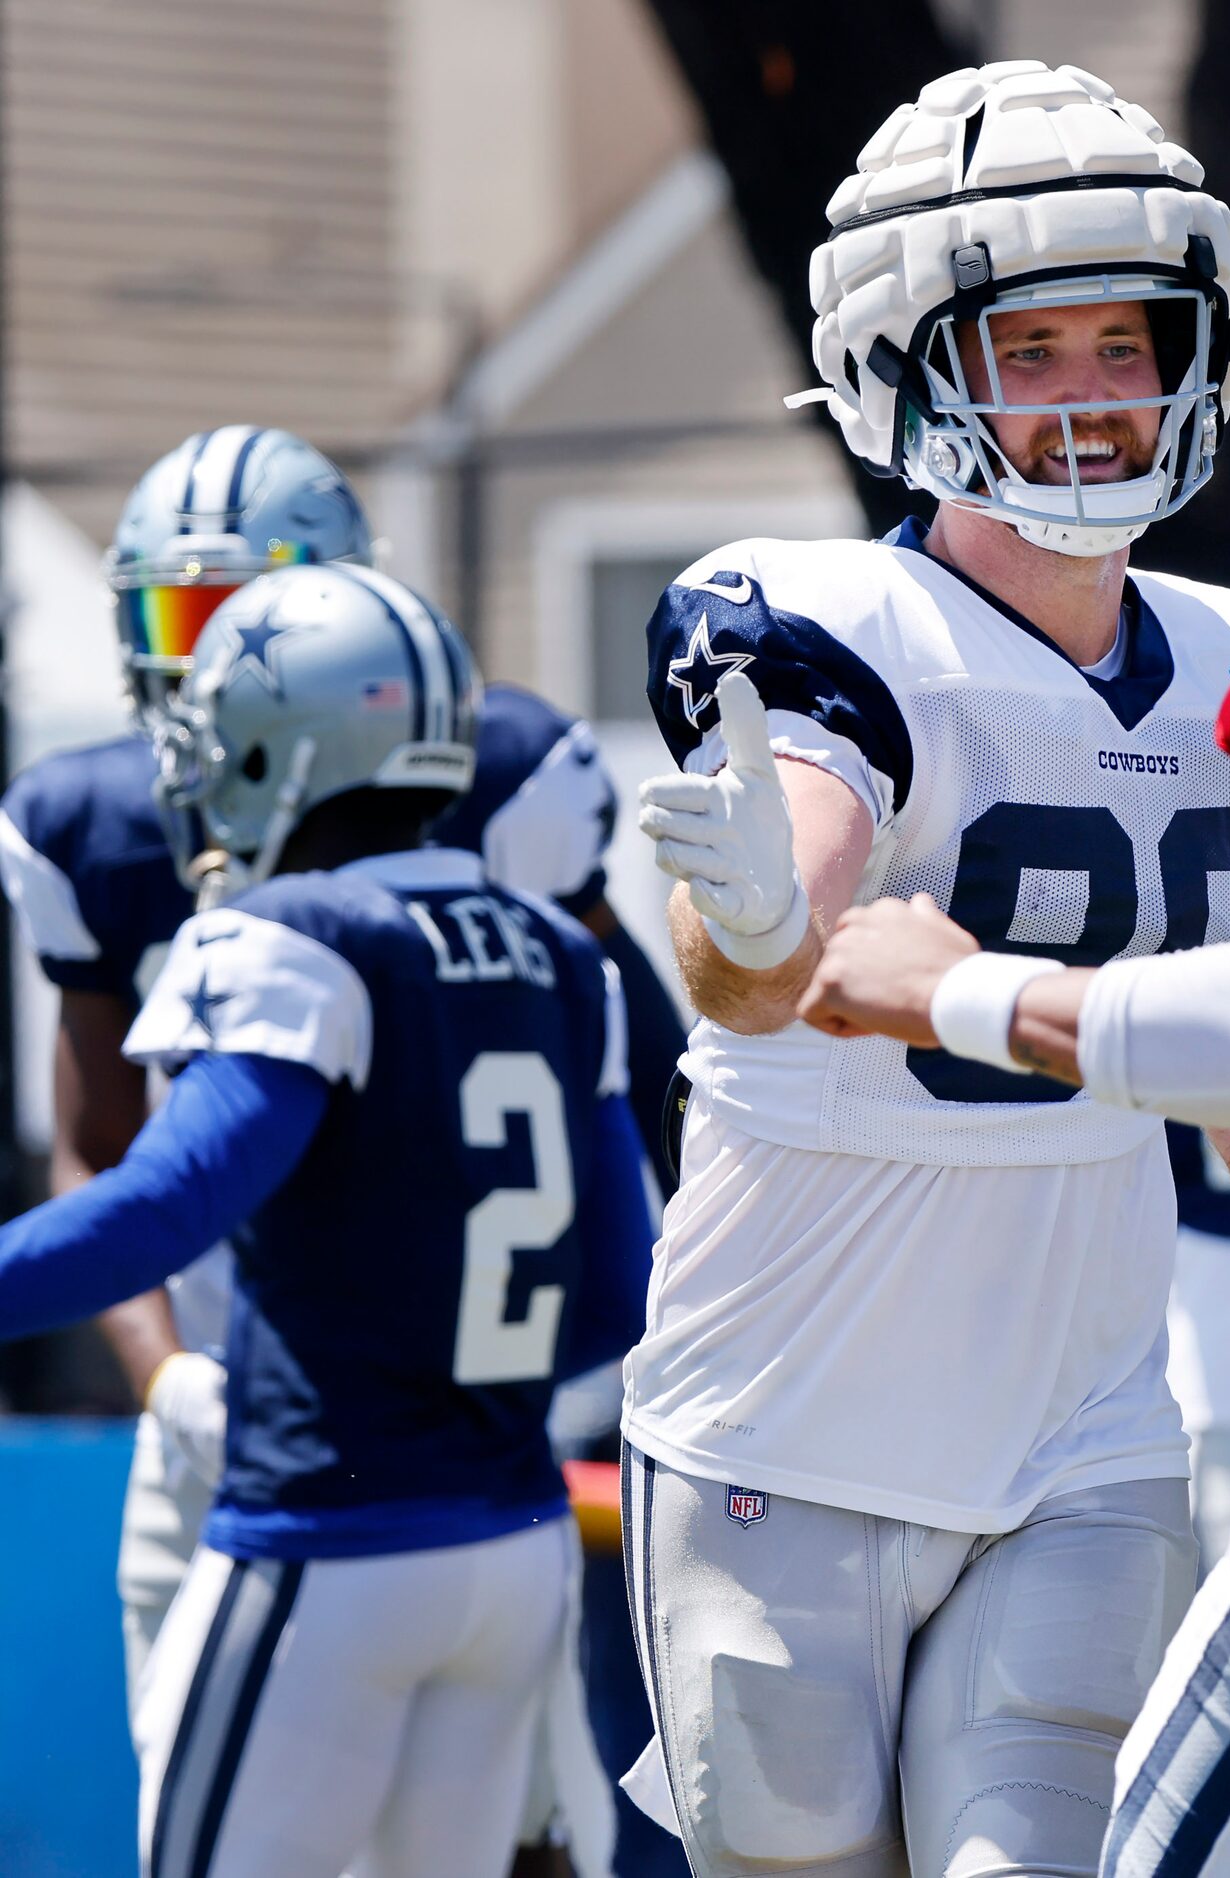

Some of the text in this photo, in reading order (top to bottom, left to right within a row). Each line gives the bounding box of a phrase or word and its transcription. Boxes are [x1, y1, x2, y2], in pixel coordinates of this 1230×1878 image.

[1098, 750, 1179, 775] COWBOYS
[452, 1050, 576, 1386] 2
[707, 1419, 757, 1437] RI-FIT
[731, 1496, 762, 1518] NFL
